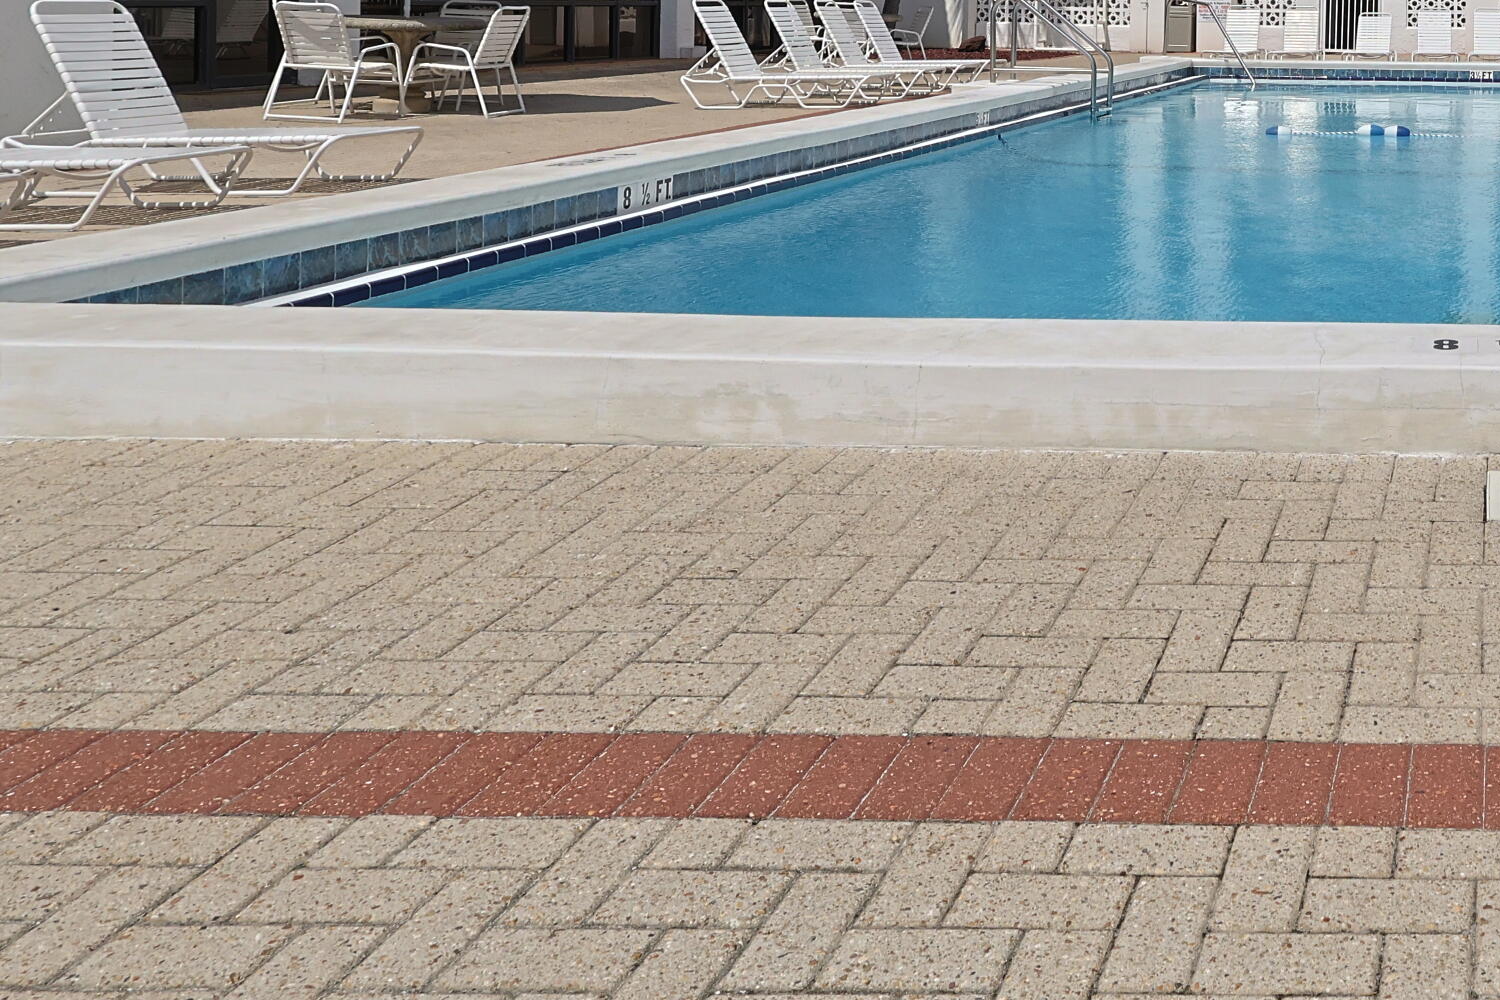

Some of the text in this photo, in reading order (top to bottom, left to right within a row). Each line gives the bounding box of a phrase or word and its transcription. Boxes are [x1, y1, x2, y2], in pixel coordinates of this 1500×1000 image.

[623, 186, 632, 209] 8
[656, 177, 672, 202] FT.
[1433, 339, 1459, 350] 8
